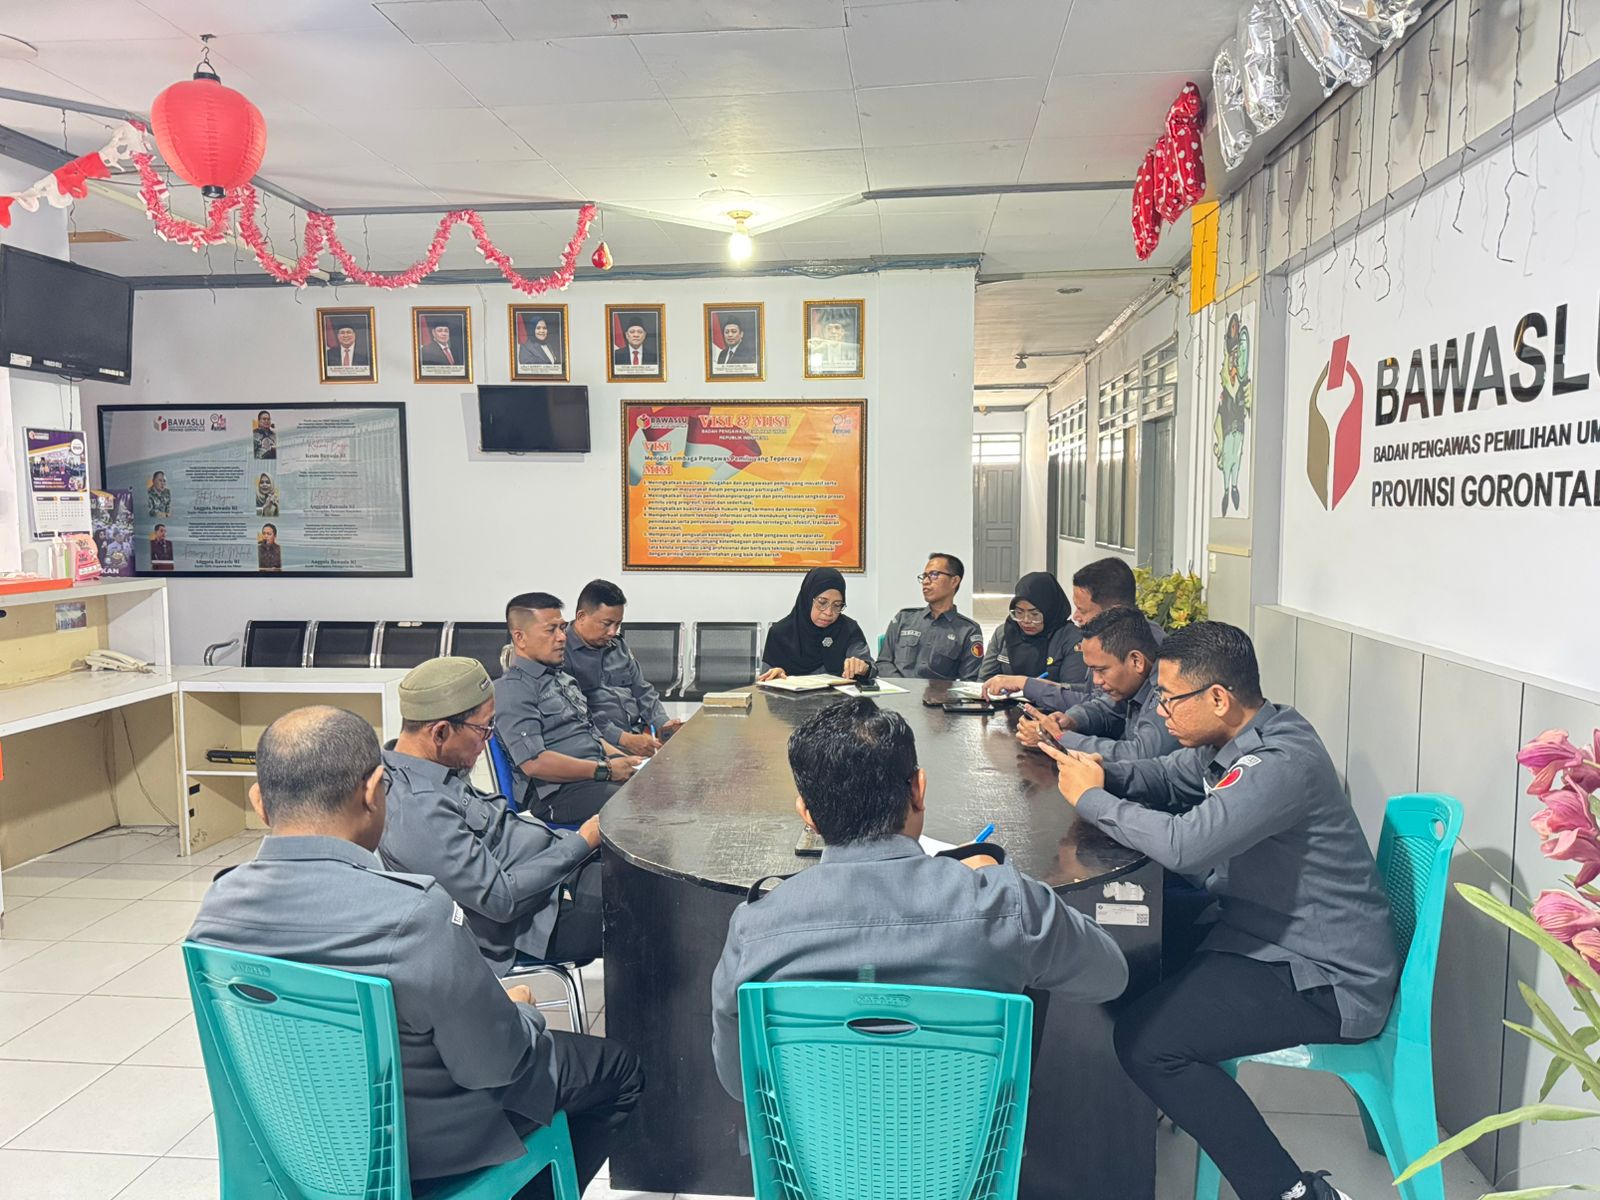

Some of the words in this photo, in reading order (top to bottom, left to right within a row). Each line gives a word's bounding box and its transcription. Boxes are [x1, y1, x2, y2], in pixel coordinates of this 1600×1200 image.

[1374, 295, 1600, 427] BAWASL
[698, 415, 733, 428] VISI
[736, 415, 749, 428] &
[755, 415, 790, 428] MISI
[644, 442, 671, 452] VISI
[1373, 442, 1410, 463] BADAN
[1411, 433, 1481, 459] PENGAWAS
[1484, 423, 1573, 453] PEMILIHAN
[644, 464, 672, 475] MISI
[1371, 476, 1455, 507] PROVINSI
